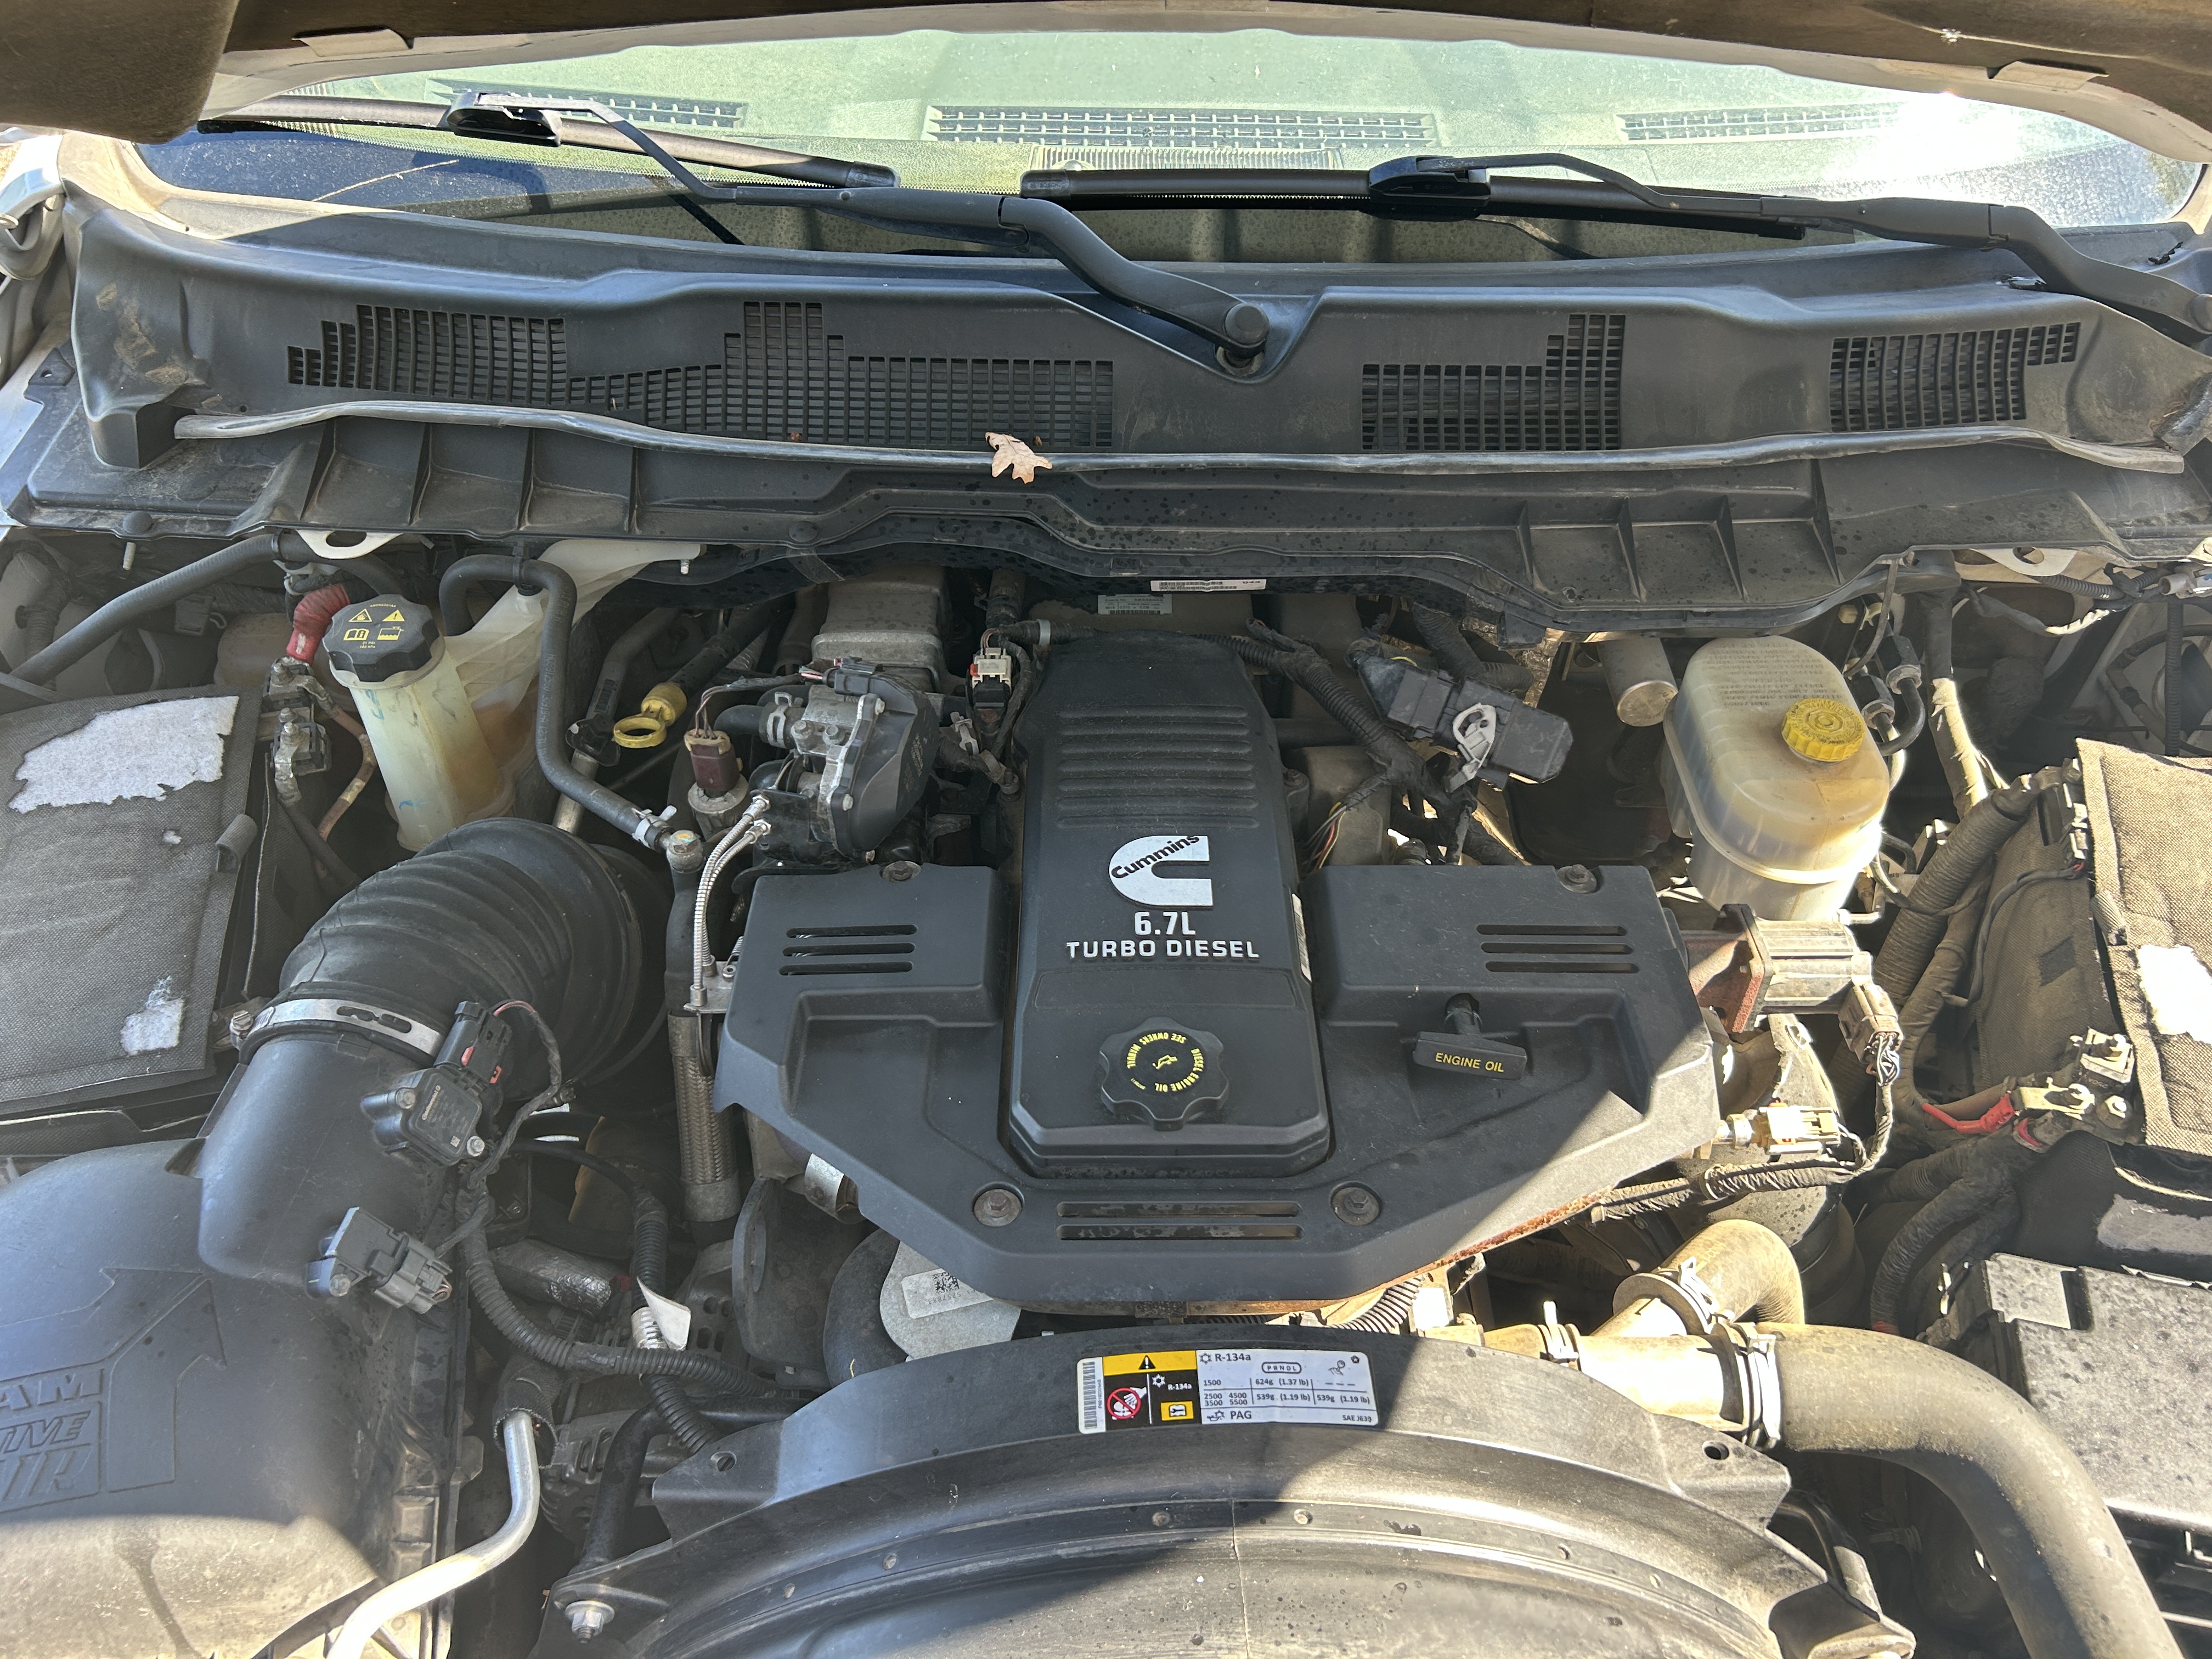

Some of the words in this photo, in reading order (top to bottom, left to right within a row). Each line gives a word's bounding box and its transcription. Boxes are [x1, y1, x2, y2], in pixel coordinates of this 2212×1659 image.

[1111, 834, 1200, 879] Cummins
[1134, 911, 1197, 936] 6.7L
[1066, 940, 1156, 959] TURBO
[1166, 940, 1260, 959] DIESEL
[1170, 1032, 1188, 1044] SEE
[1126, 1043, 1142, 1069] MANUAL
[1190, 1048, 1205, 1072] DIESEL
[1435, 1052, 1481, 1069] ENGINE
[1485, 1060, 1505, 1073] OIL
[1154, 1082, 1169, 1092] OIL
[1170, 1071, 1200, 1092] ENGINE
[1215, 1353, 1251, 1362] R-134a
[1279, 1378, 1297, 1387] (1.37
[1299, 1379, 1309, 1387] lb)
[1280, 1393, 1299, 1402] (1.19
[1300, 1393, 1310, 1402] lb)
[1317, 1394, 1335, 1403] 539g
[1340, 1395, 1358, 1404] (1.19
[1360, 1396, 1370, 1404] lb)
[1230, 1410, 1252, 1420] PAG
